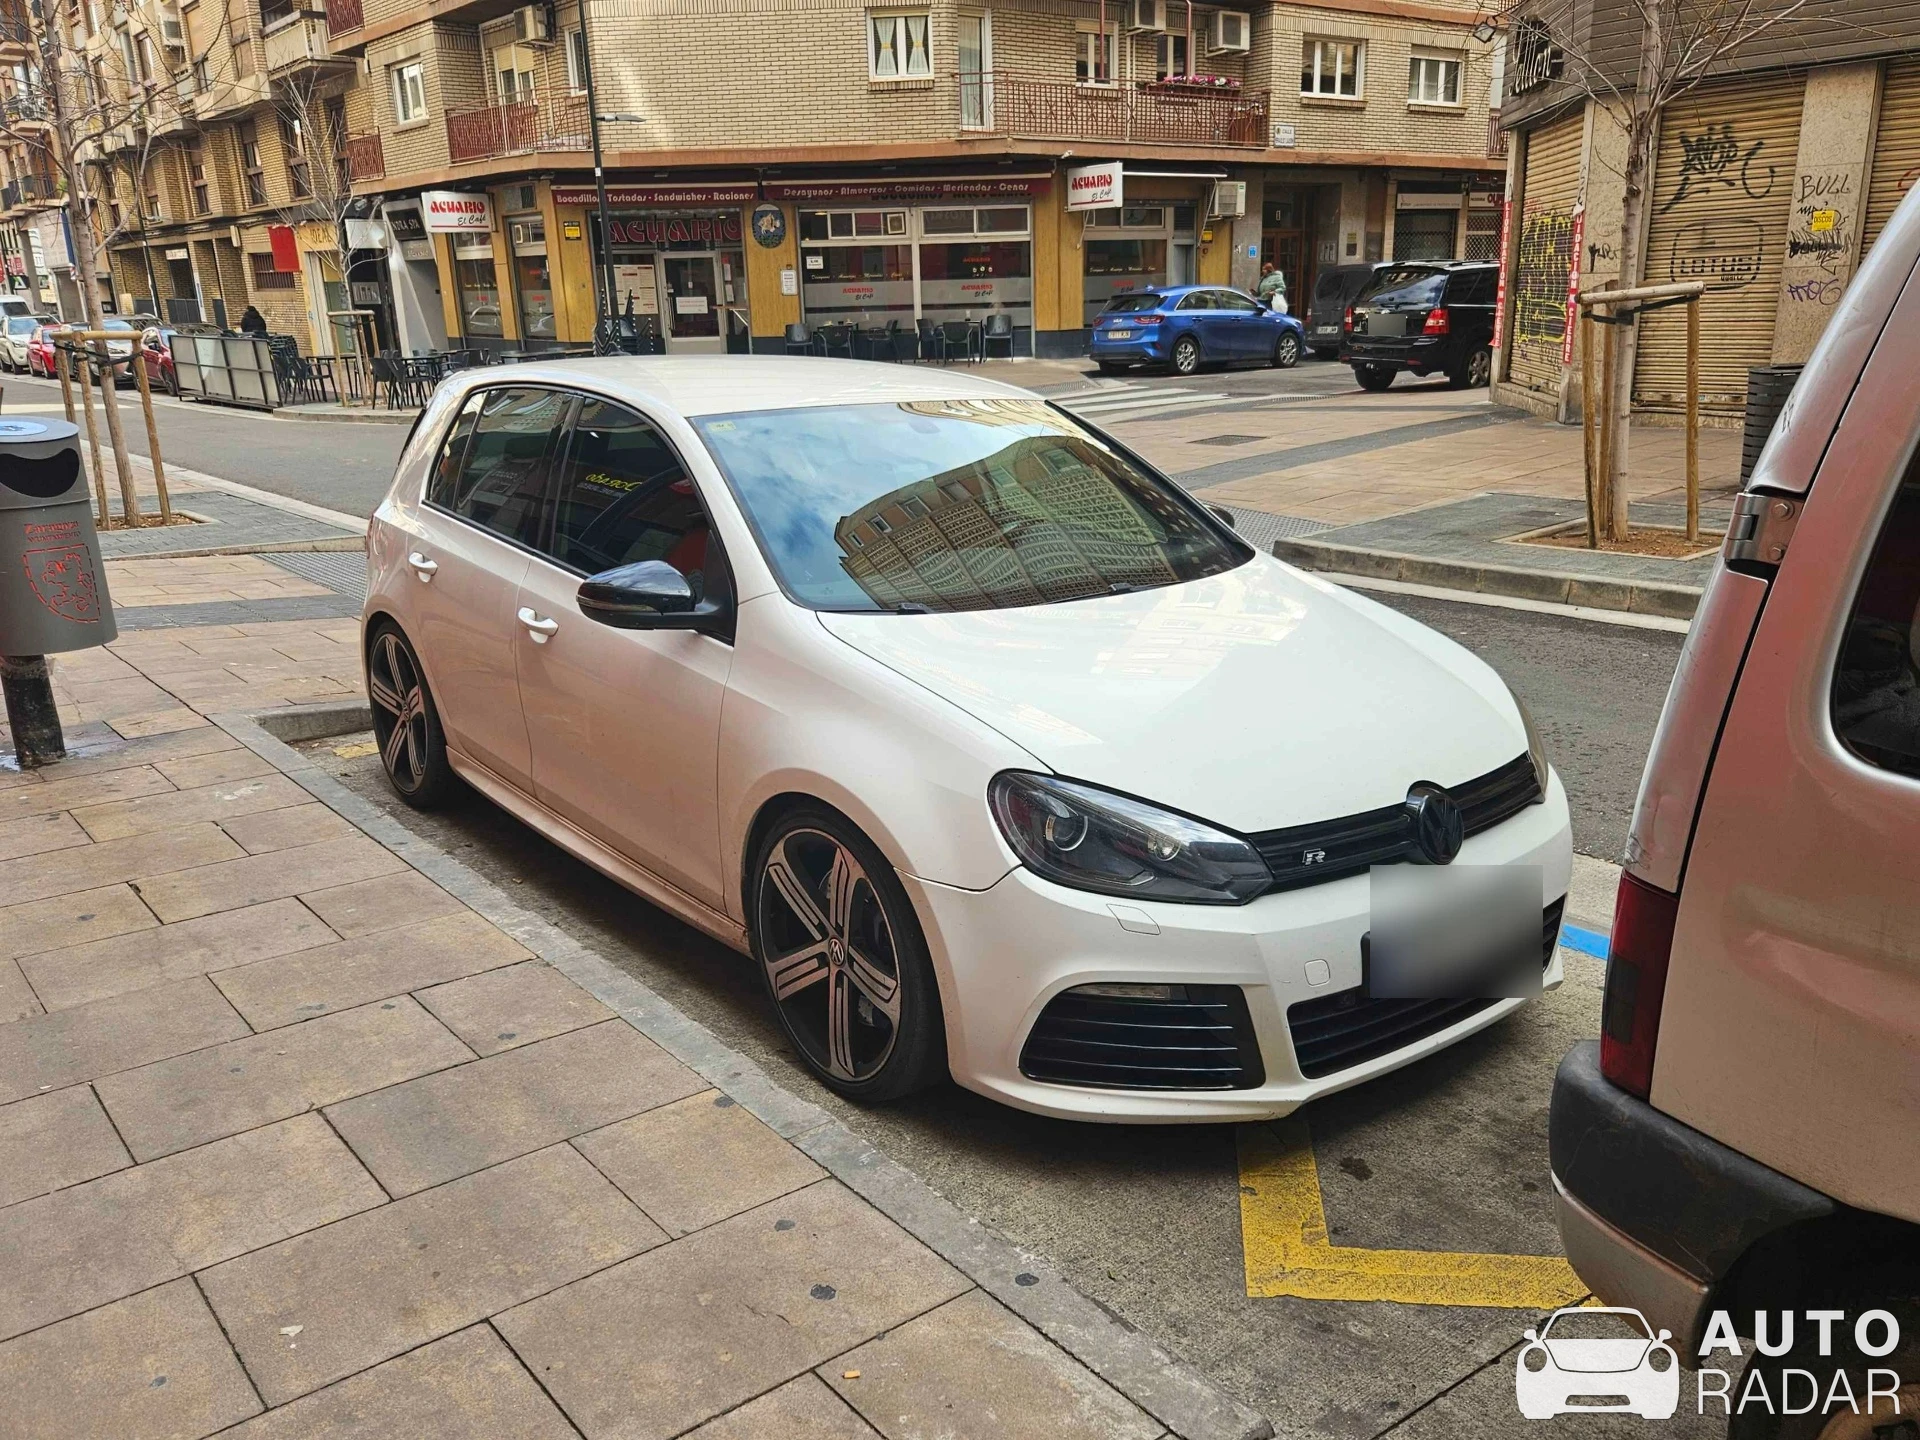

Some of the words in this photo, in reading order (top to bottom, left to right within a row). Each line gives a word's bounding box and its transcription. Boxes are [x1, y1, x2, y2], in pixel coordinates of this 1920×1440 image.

[1071, 173, 1113, 191] ACUARIO
[1797, 174, 1850, 203] BULL
[607, 192, 647, 202] Tostadas
[654, 191, 706, 201] Sandwiches
[713, 190, 754, 200] Raciones
[784, 187, 833, 199] Desayunos
[894, 183, 936, 193] Comidas
[943, 181, 992, 191] Meriendas
[998, 181, 1029, 191] Cenas
[1091, 193, 1098, 202] El
[430, 201, 485, 214] ACUARIO
[457, 216, 466, 226] El
[608, 217, 742, 243] ACUARIO
